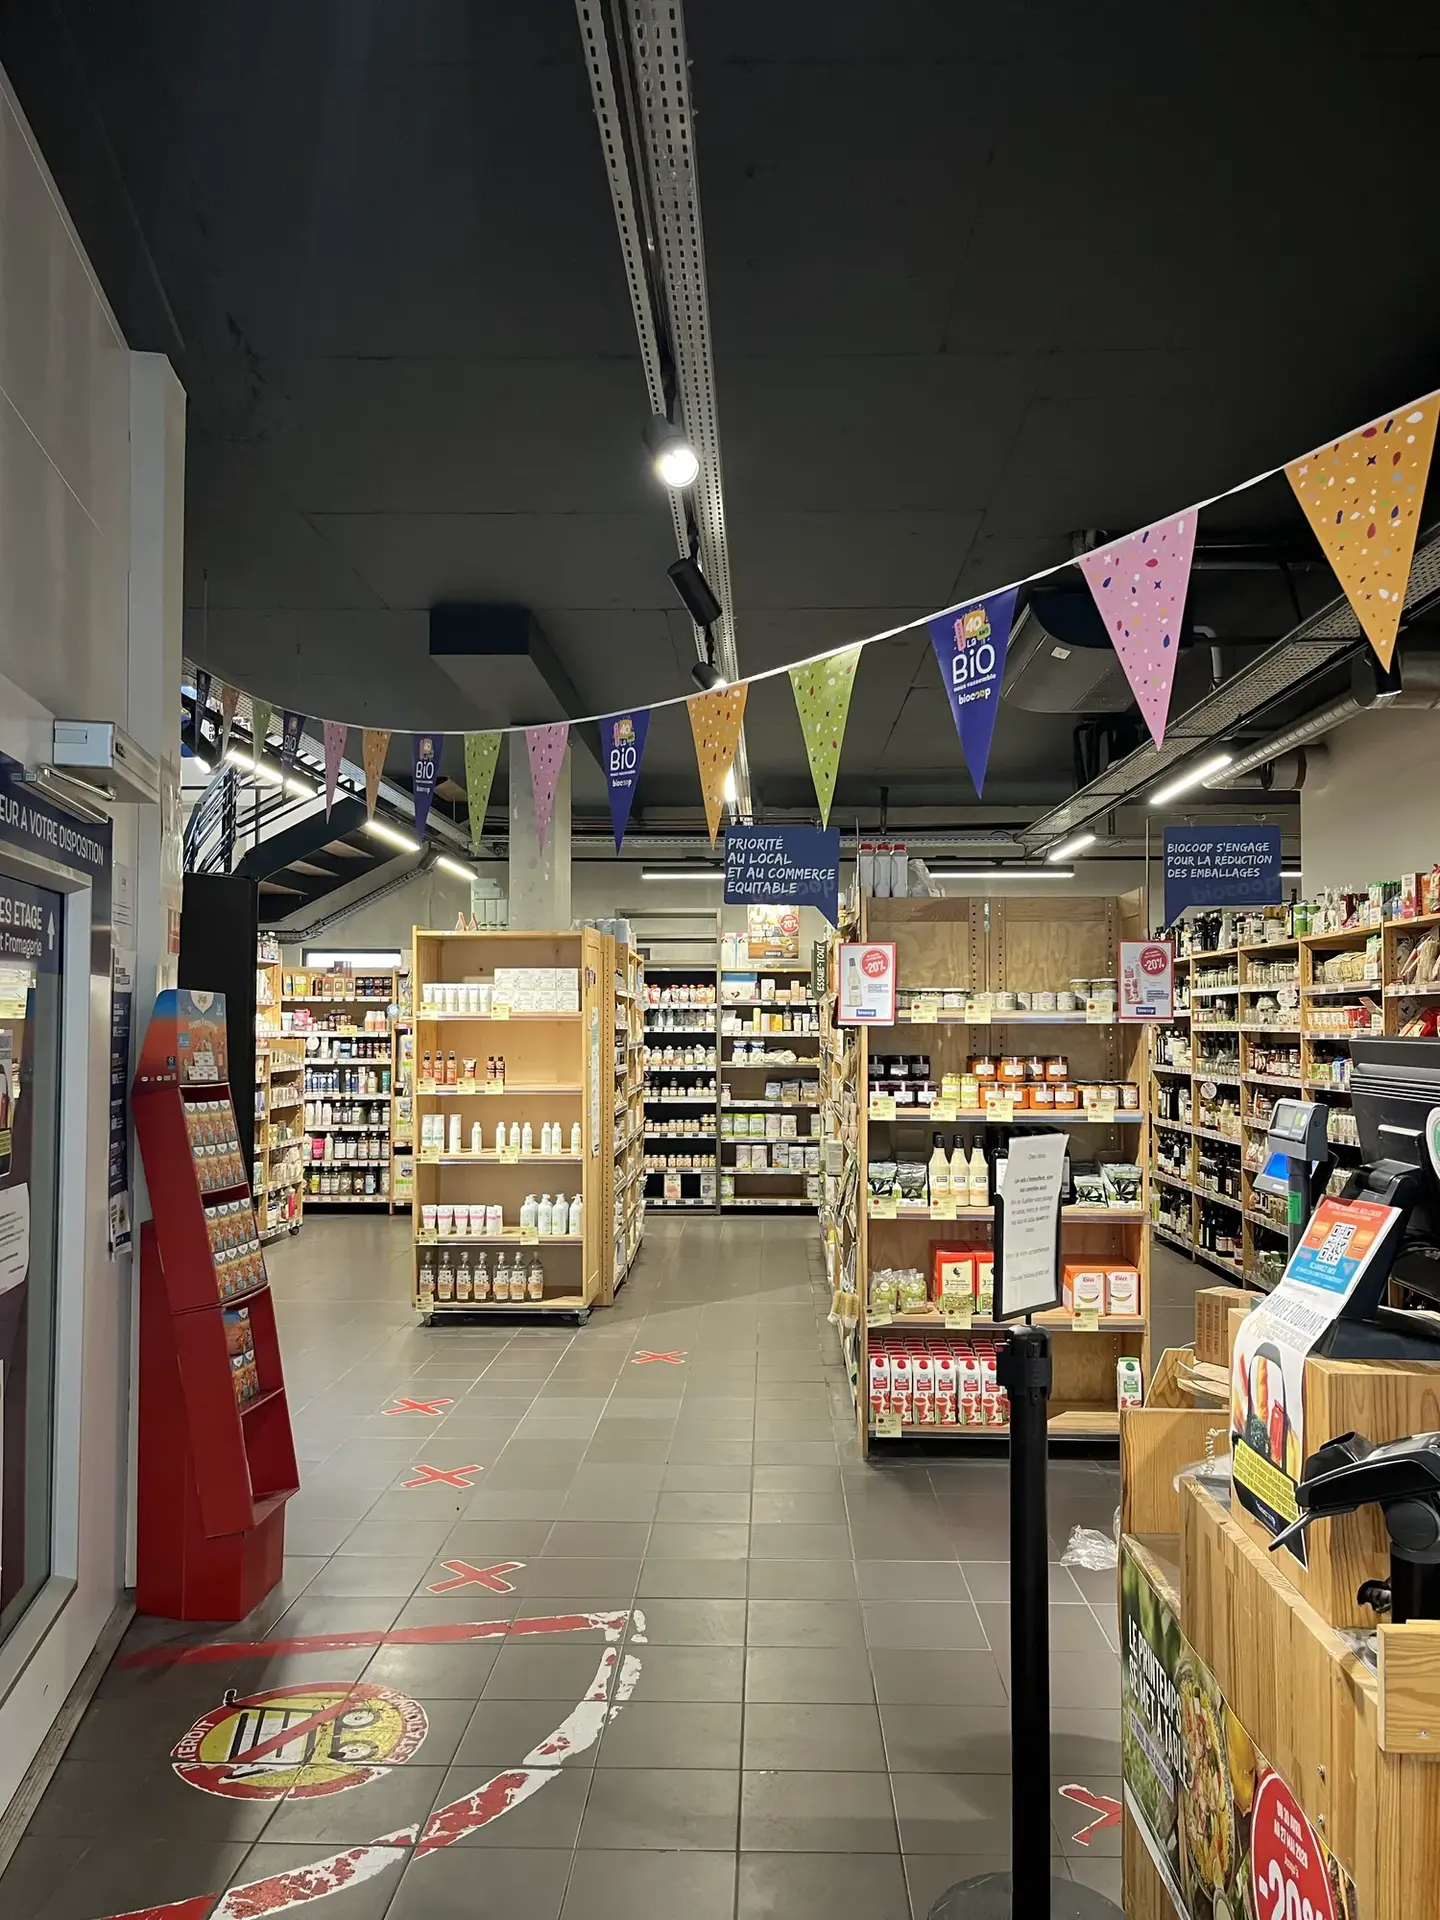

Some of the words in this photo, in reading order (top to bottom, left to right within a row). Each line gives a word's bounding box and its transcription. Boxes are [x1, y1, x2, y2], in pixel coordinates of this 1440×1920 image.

[966, 616, 982, 633] 40
[952, 643, 996, 685] BiO
[958, 687, 991, 705] biocoop
[610, 746, 637, 772] BiO
[415, 761, 435, 779] BiO
[21, 811, 28, 831] A
[29, 811, 58, 846] VOTRE
[59, 825, 104, 866] DISPOSITION
[728, 836, 784, 850] PRIORITÉ
[1167, 843, 1213, 853] BIOCOOP
[1216, 842, 1270, 853] S'ENGAGE
[727, 853, 745, 864] AU
[749, 853, 792, 865] LOCAL
[1167, 855, 1195, 866] POUR
[1198, 856, 1211, 866] LA
[1215, 853, 1272, 866] RÉDUCTION
[727, 867, 743, 879] ET
[746, 867, 763, 879] AU
[768, 868, 835, 880] COMMERCE
[1167, 868, 1187, 878] DES
[1190, 868, 1260, 878] EMBALLAGES
[727, 879, 797, 894] ÉQUITABLE
[14, 900, 43, 931] ETAGE
[5, 932, 42, 959] Fromagerie
[816, 943, 826, 992] ESSUIE-TOUT
[865, 960, 887, 974] -20%
[1144, 957, 1165, 971] -20%
[1128, 1614, 1138, 1657] LE
[1138, 1630, 1182, 1734] PRINTEMPS
[1129, 1654, 1138, 1698] SE
[1139, 1674, 1155, 1727] MET
[1163, 1713, 1190, 1794] TABLE
